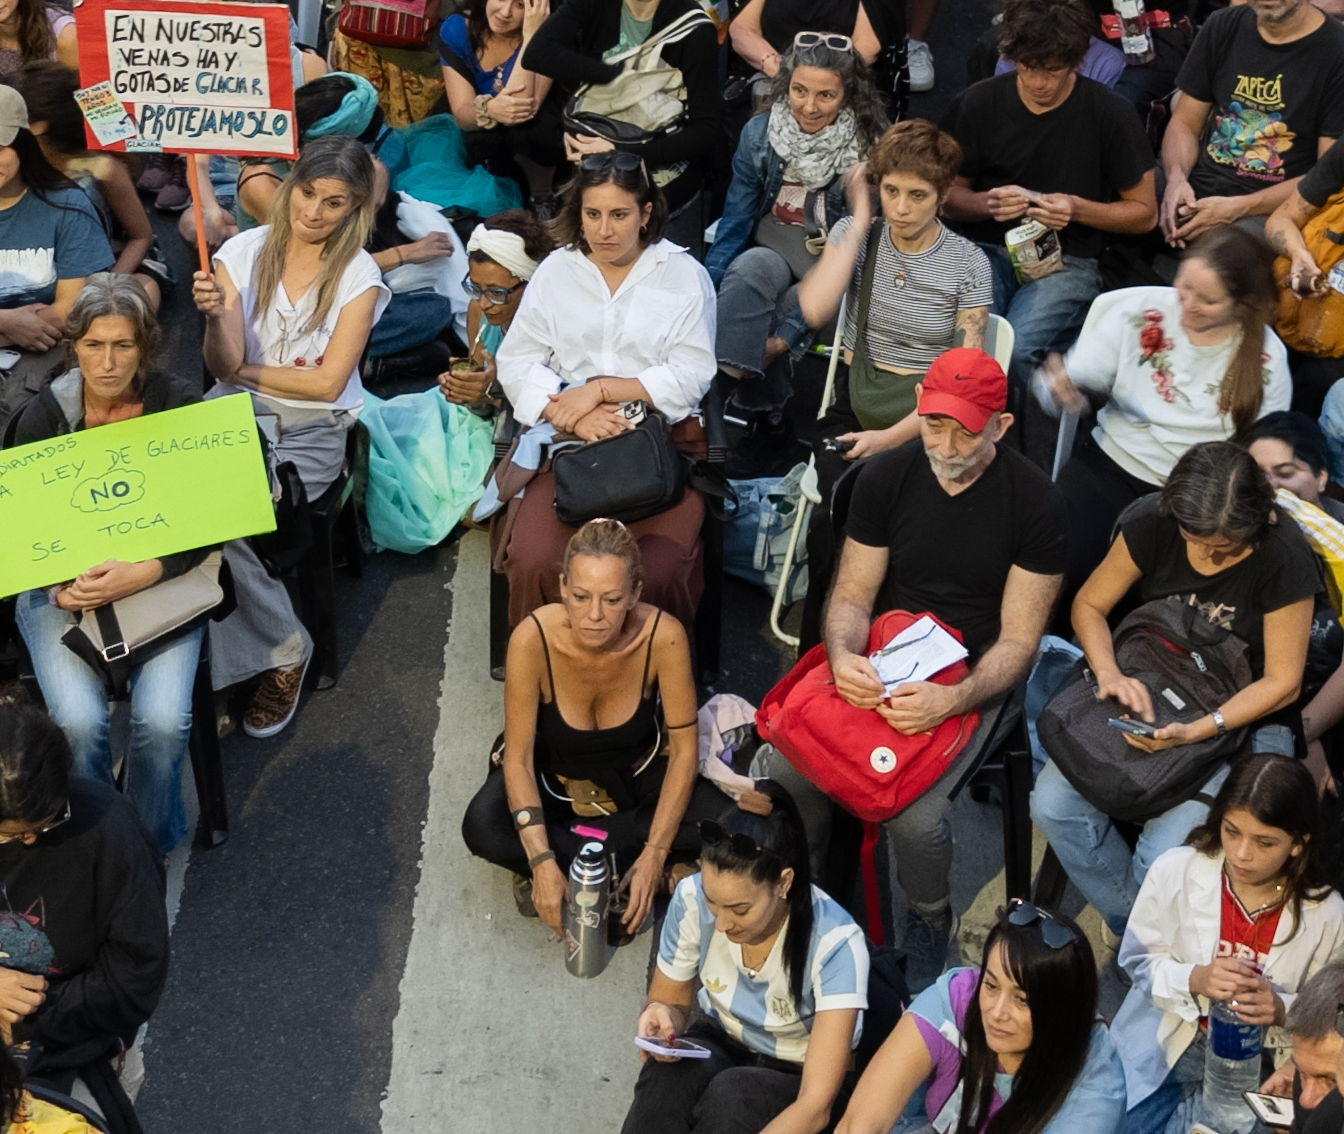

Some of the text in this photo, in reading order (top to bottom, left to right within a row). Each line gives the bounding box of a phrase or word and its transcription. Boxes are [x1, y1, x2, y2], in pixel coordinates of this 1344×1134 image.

[112, 15, 262, 47] EN NUESTRAS
[118, 48, 237, 72] VENAS HAY
[114, 70, 263, 96] GOTAS DE GLACIAR
[1234, 73, 1283, 105] ZAPECÁ
[138, 104, 288, 143] PROTEJAMOSLO
[41, 459, 86, 485] LEY
[105, 445, 132, 471] DE
[146, 429, 250, 458] GLACIARES
[90, 481, 131, 505] NO
[31, 512, 170, 562] SE TOCA
